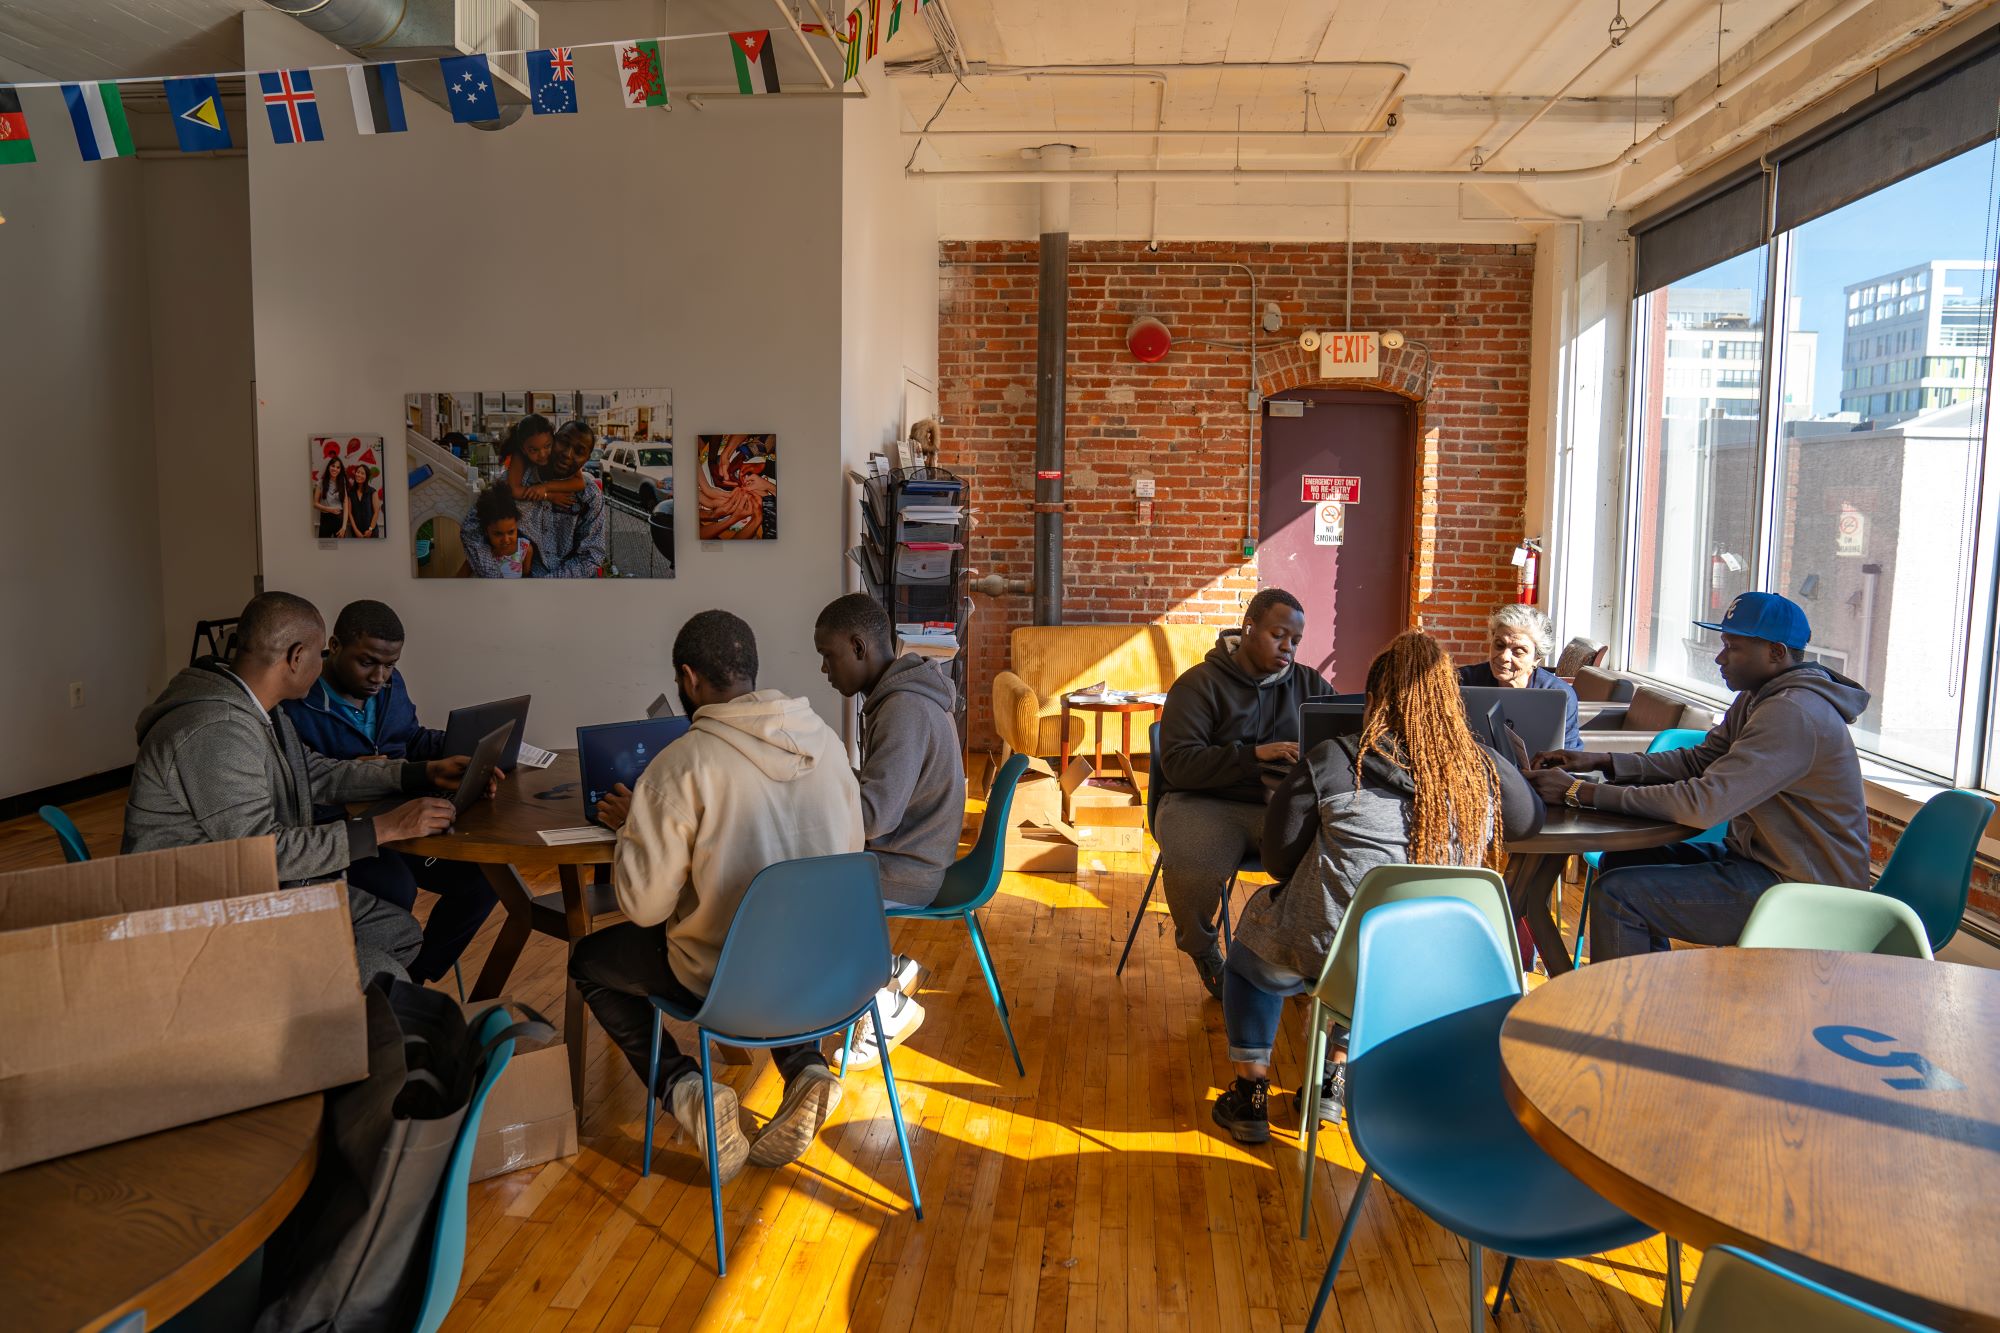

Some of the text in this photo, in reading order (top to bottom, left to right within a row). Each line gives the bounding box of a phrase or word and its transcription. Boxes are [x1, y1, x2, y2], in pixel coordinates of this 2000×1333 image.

[1333, 335, 1369, 363] EXIT
[1305, 477, 1333, 485] EMERGENCY
[1334, 478, 1344, 486] EXIT
[1311, 485, 1351, 493] NO RE-ENTRY
[1321, 493, 1350, 501] BUILDING
